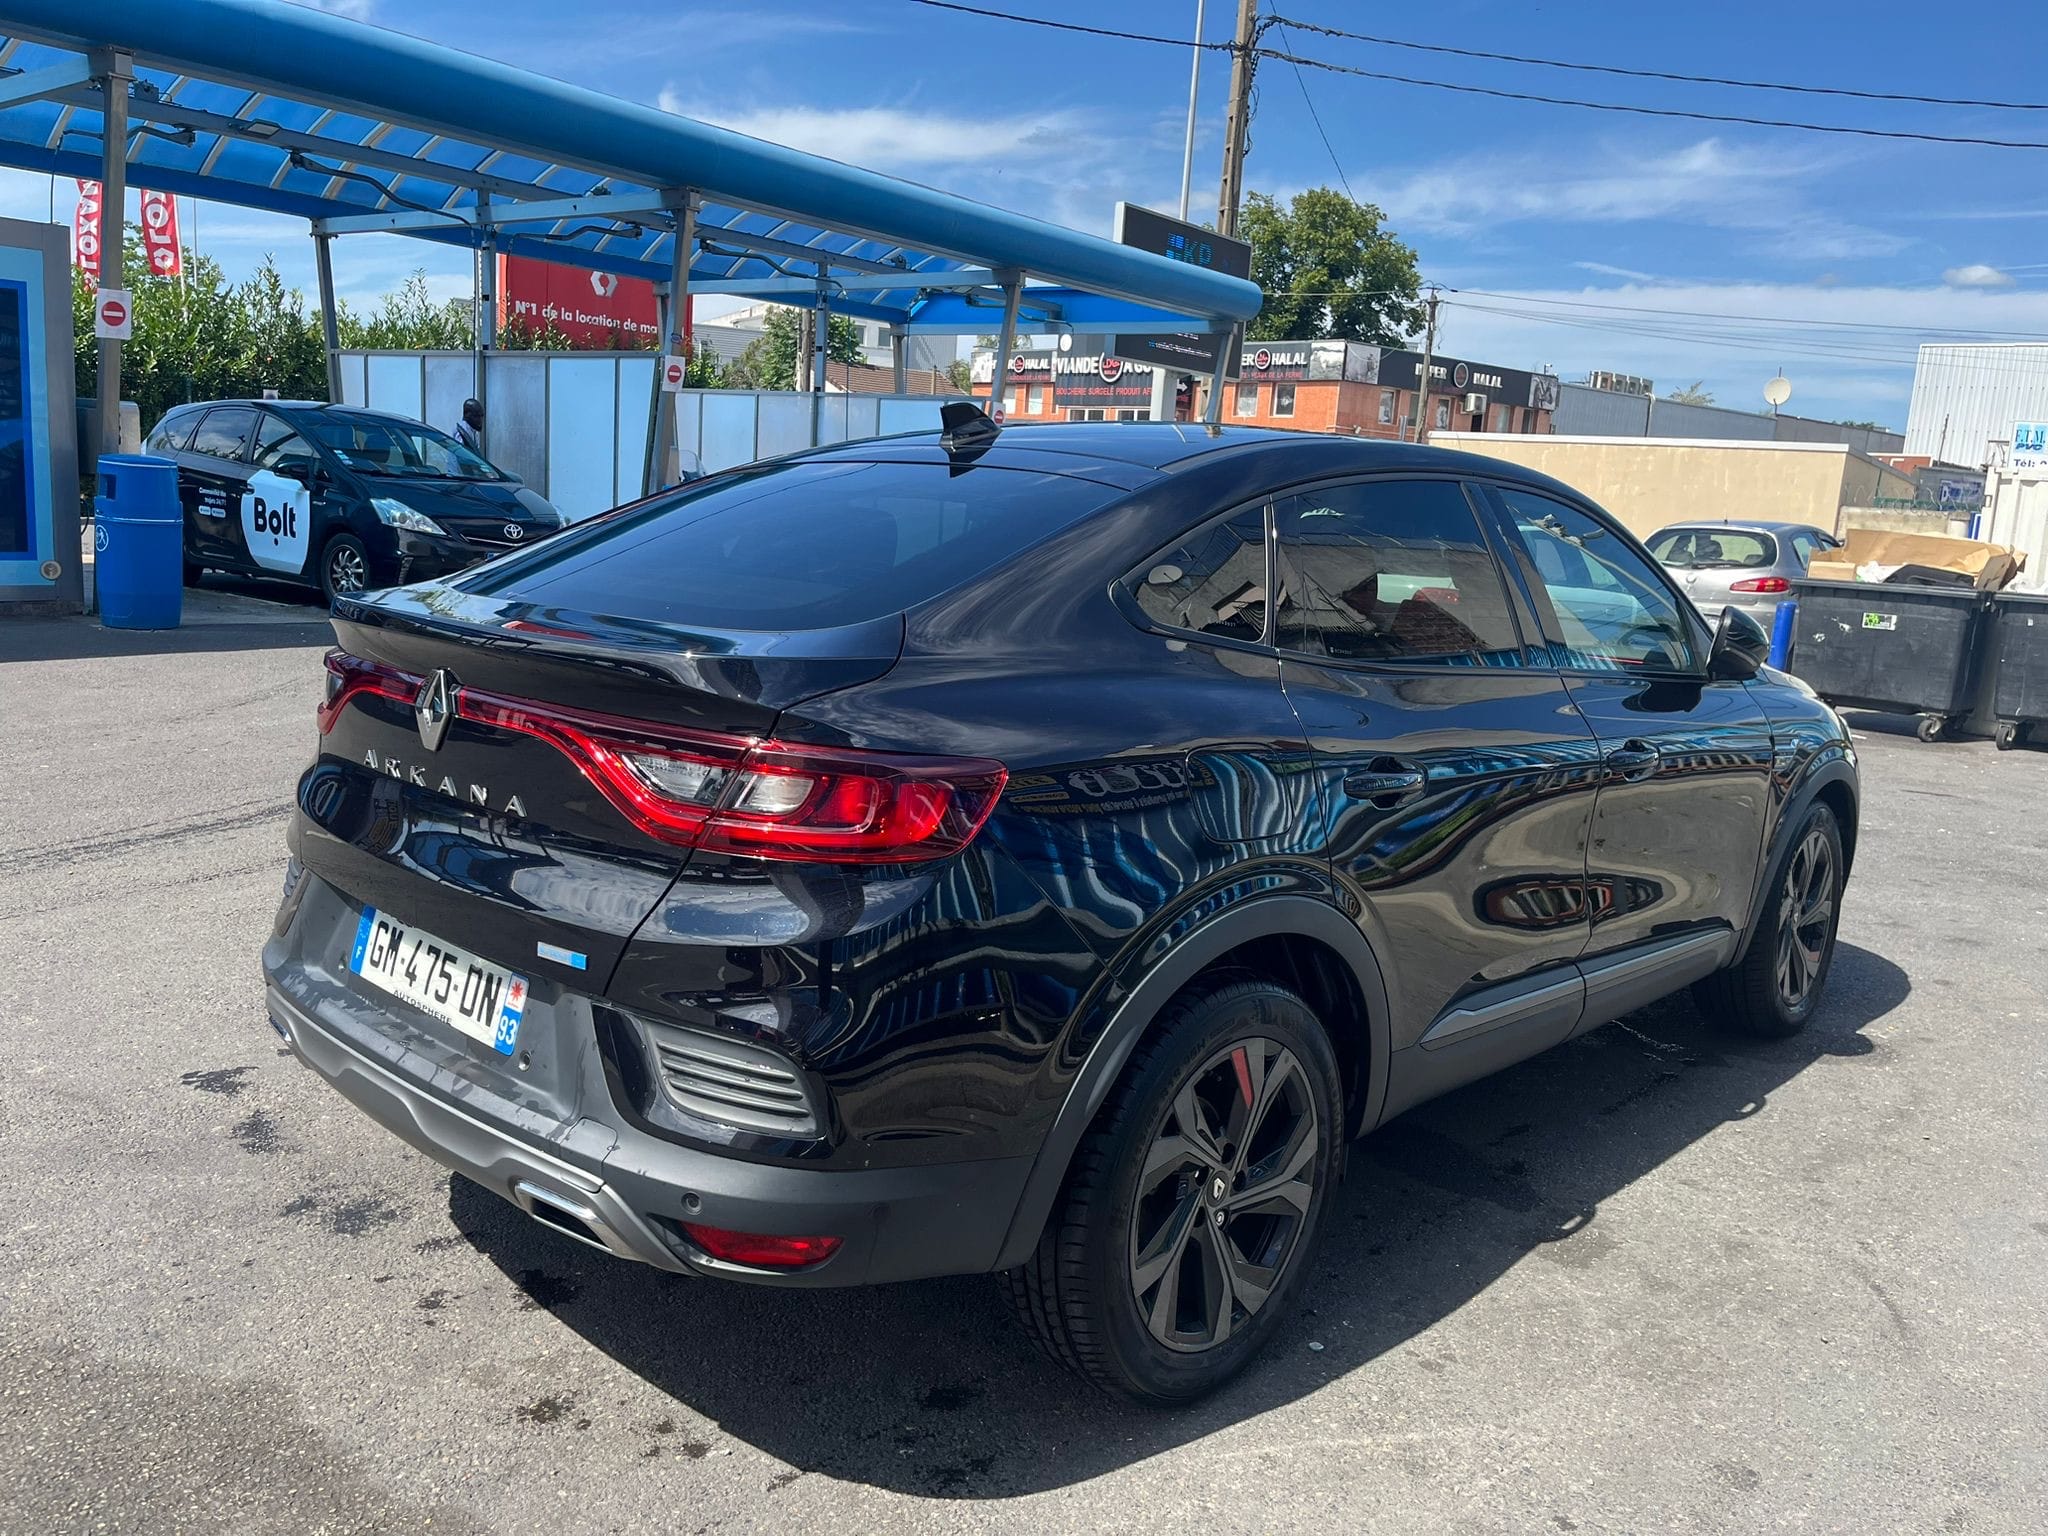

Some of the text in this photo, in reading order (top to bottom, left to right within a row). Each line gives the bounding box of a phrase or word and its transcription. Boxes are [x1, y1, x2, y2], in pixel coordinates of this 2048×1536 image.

[542, 304, 558, 319] de
[561, 307, 573, 321] la
[576, 310, 621, 328] location
[623, 319, 637, 332] de
[1025, 358, 1050, 369] HALAL
[1057, 356, 1099, 374] VIANDE
[1272, 352, 1307, 365] HALAL
[254, 497, 296, 546] Bolt
[364, 749, 528, 818] ARKANA
[498, 1015, 518, 1045] 93
